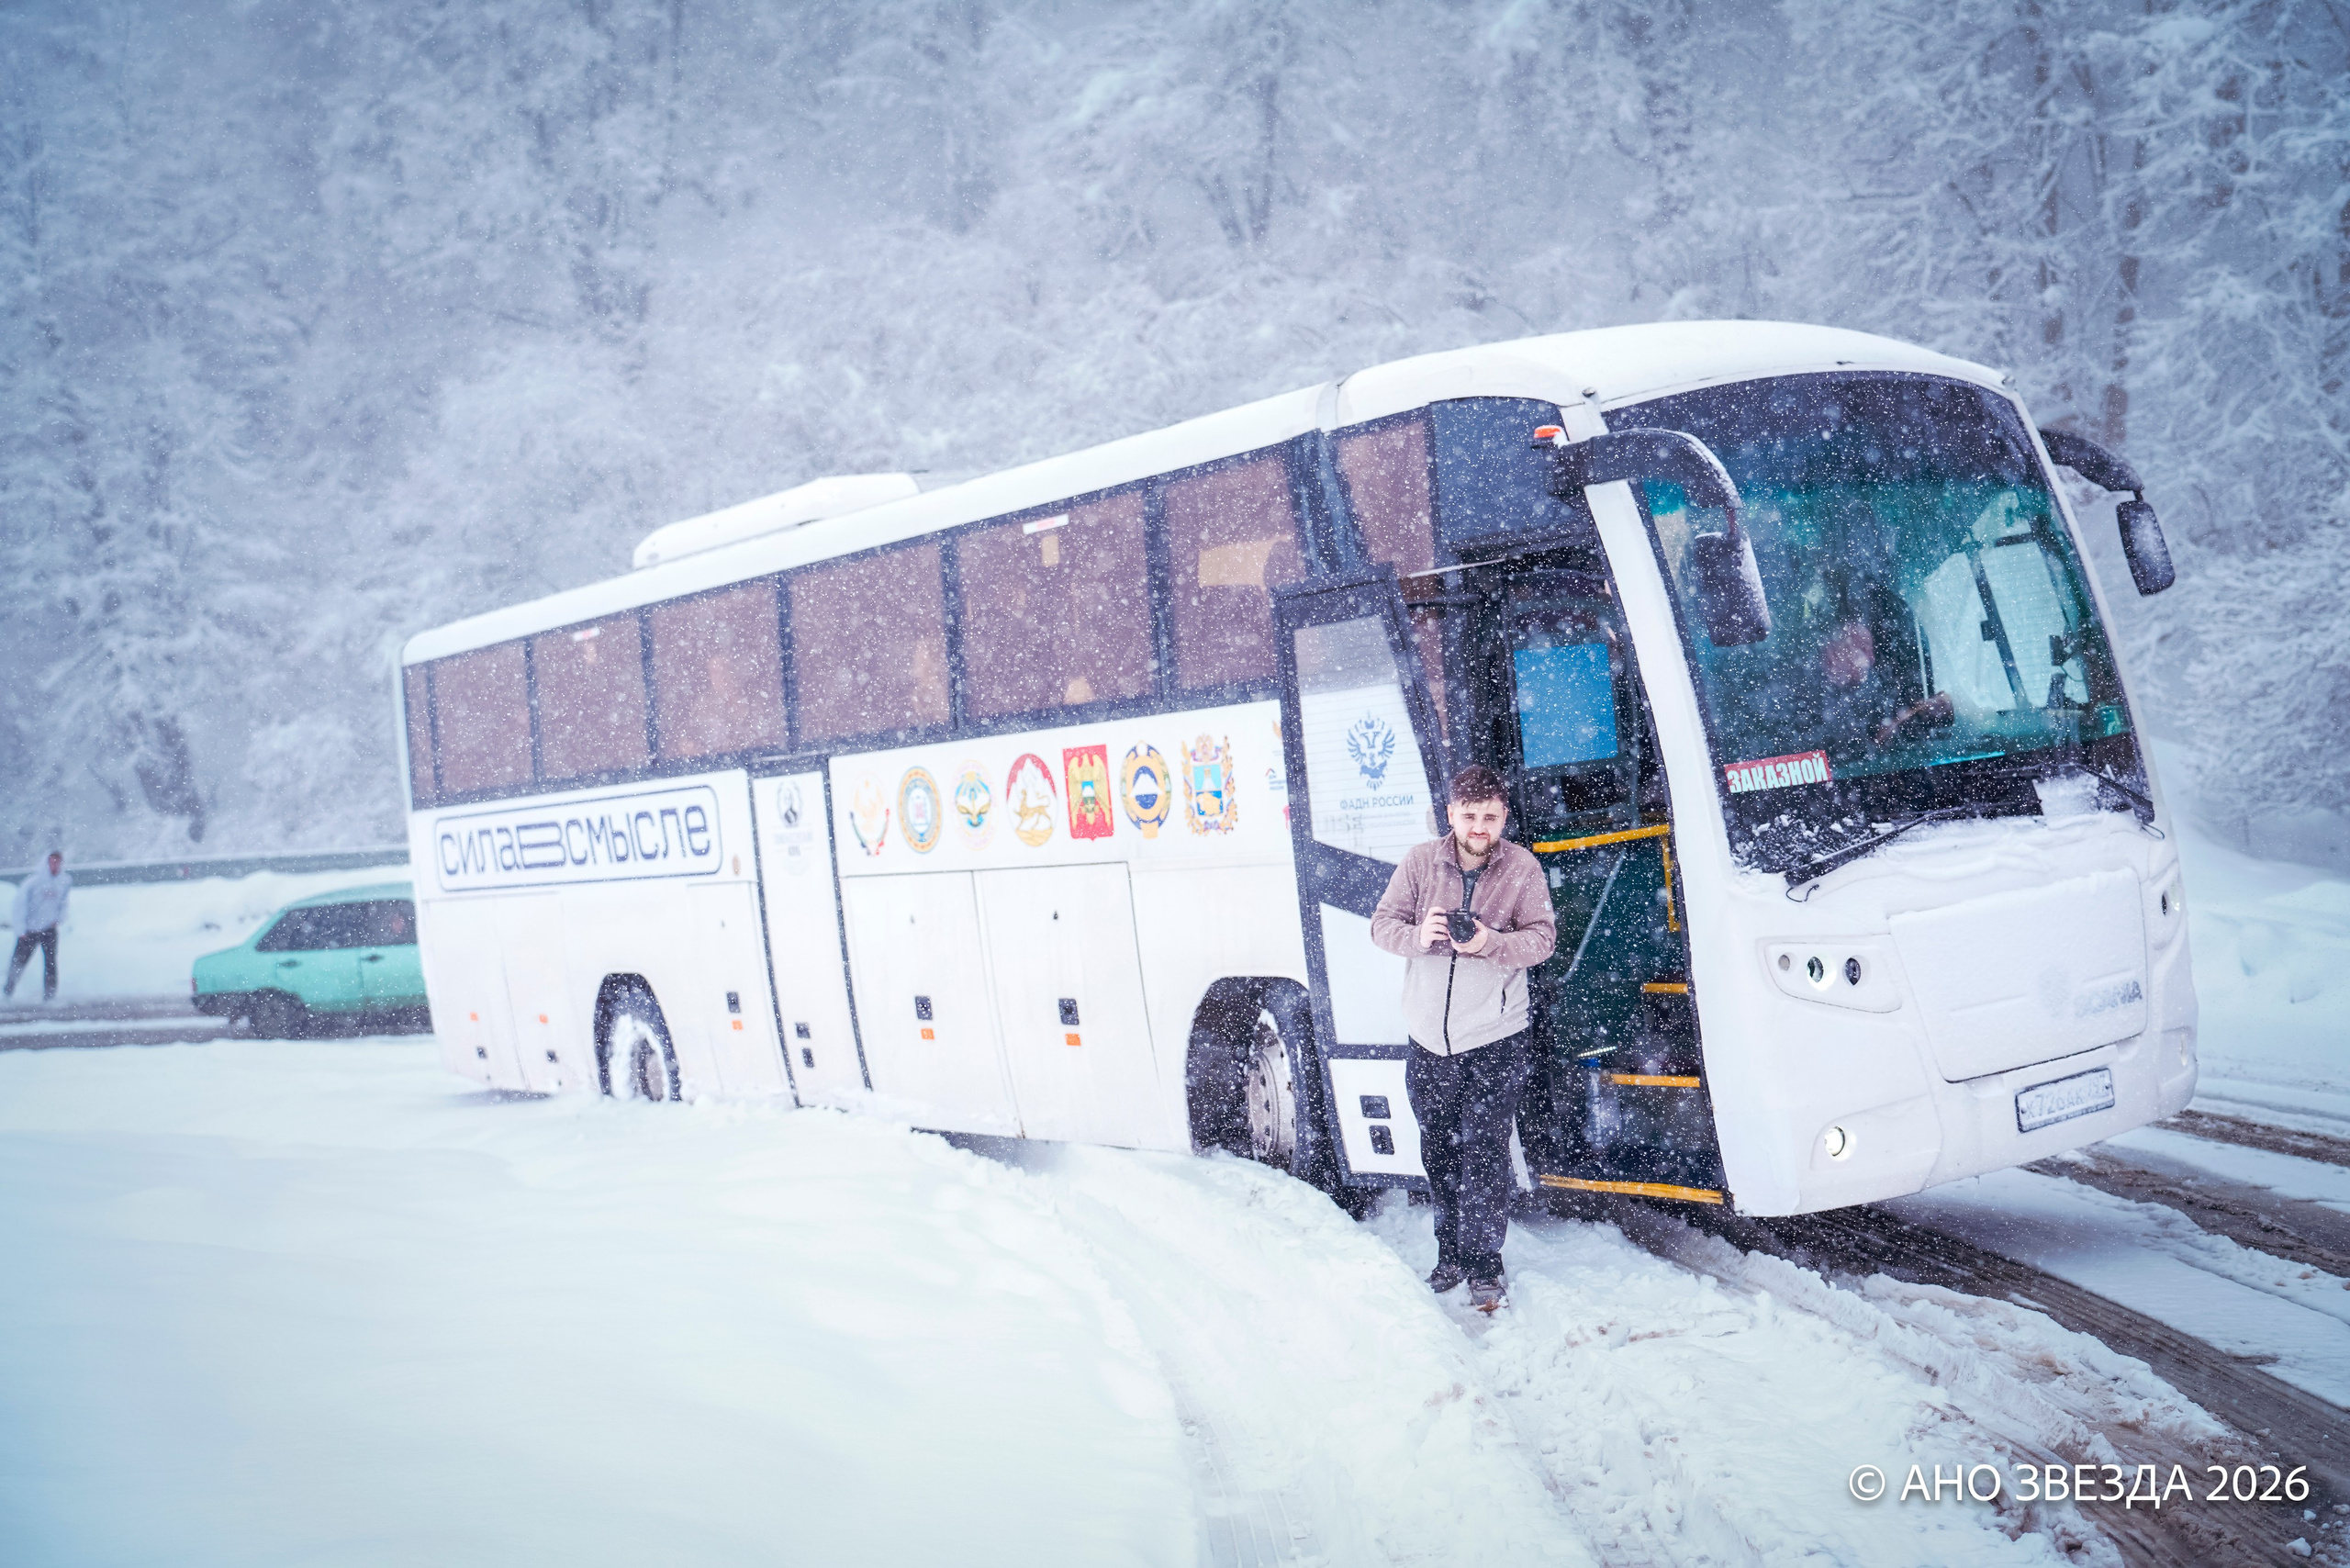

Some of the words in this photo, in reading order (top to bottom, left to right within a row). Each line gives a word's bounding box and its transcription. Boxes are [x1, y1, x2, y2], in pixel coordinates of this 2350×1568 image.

[1727, 752, 1828, 793] ЗАКАЗНОЙ
[1340, 798, 1369, 810] ФАДН
[1372, 795, 1414, 808] РОССИИ
